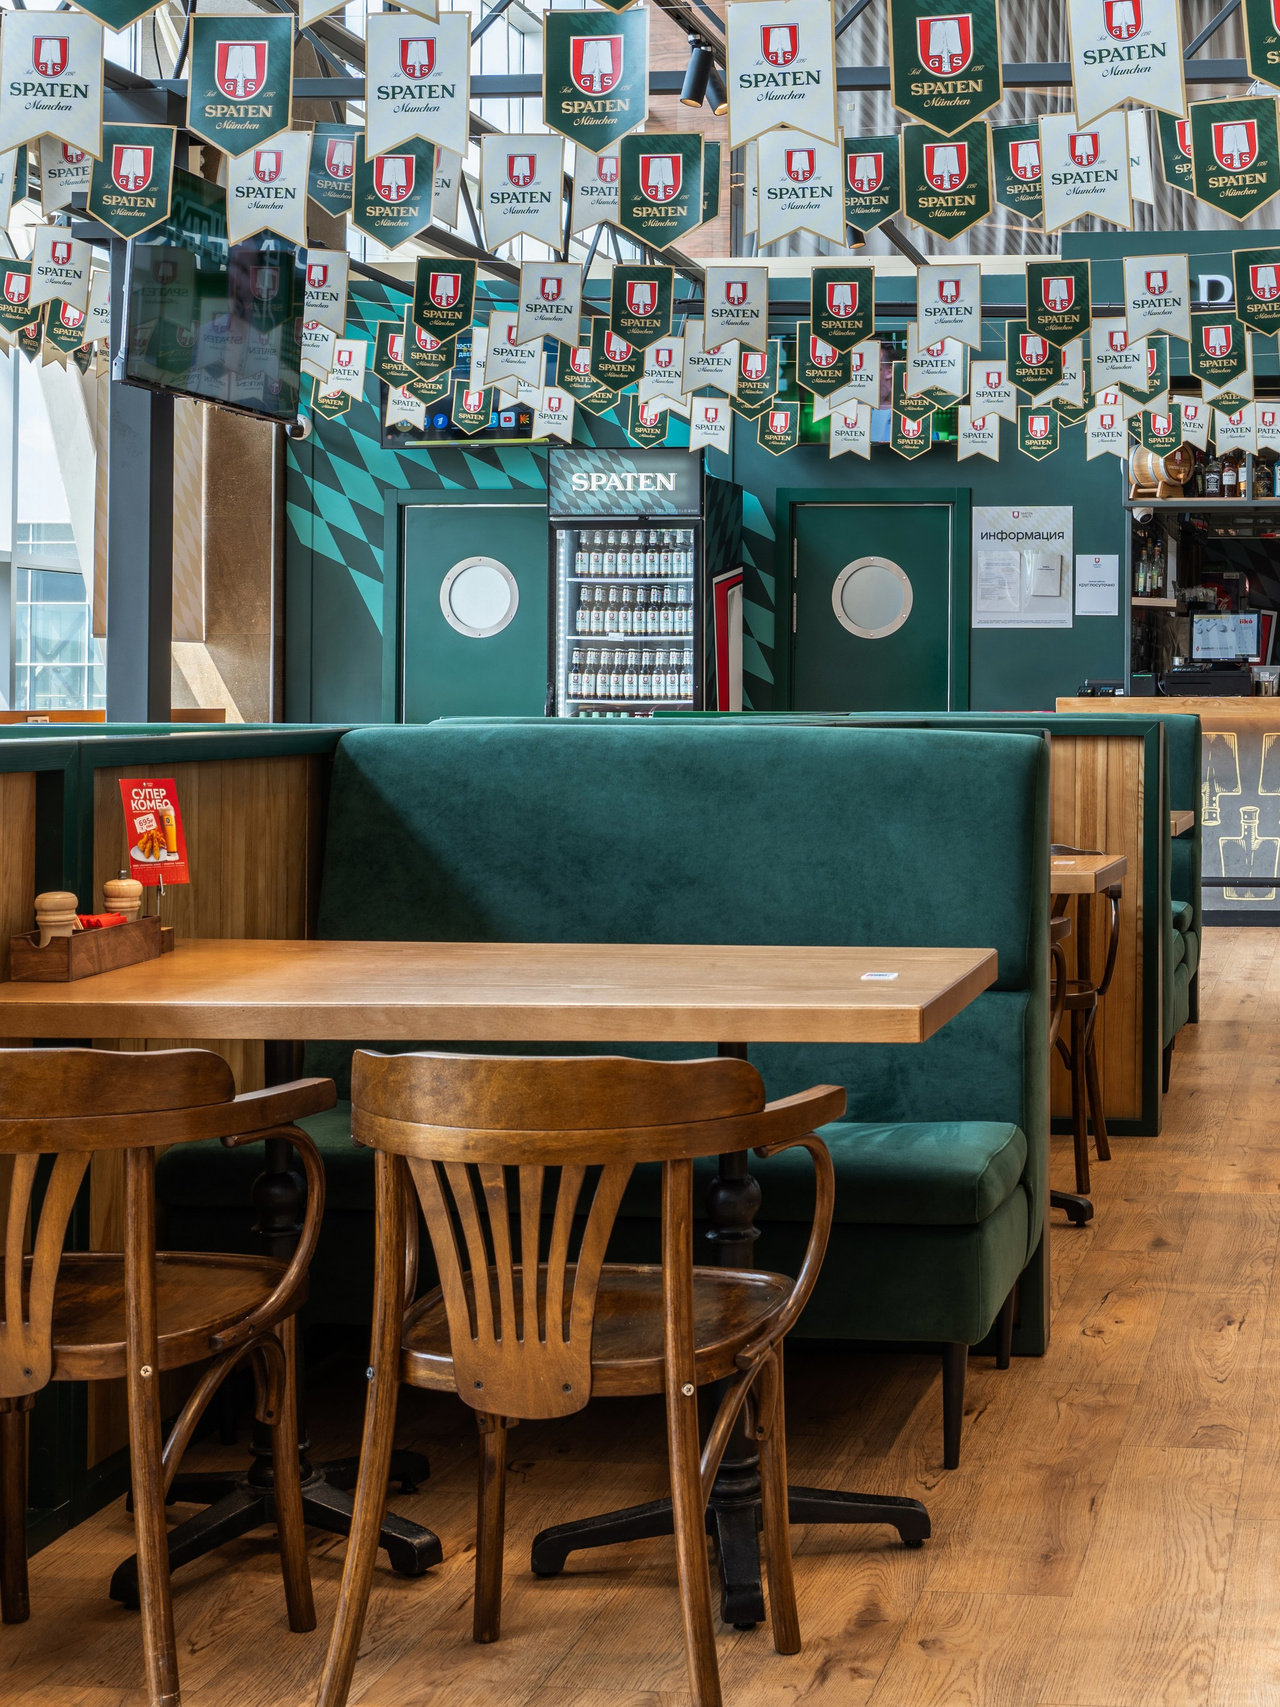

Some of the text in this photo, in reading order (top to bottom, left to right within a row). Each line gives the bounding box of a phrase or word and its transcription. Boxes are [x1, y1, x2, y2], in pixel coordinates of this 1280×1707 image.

[1083, 42, 1167, 65] SPATEN
[739, 70, 821, 89] SPATEN
[9, 82, 89, 99] SPATEN
[376, 84, 456, 100] SPATEN
[910, 79, 984, 96] SPATEN
[561, 99, 630, 114] SPATEN
[923, 97, 971, 107] München
[205, 104, 273, 118] SPATEN
[215, 119, 260, 130] München
[573, 115, 618, 126] München
[1051, 169, 1118, 186] SPATEN
[1208, 171, 1267, 189] SPATEN
[235, 186, 297, 199] SPATEN
[490, 192, 551, 204] SPATEN
[767, 185, 834, 200] SPATEN
[102, 195, 156, 208] SPATEN
[918, 194, 976, 208] SPATEN
[366, 206, 419, 217] SPATEN
[632, 205, 687, 218] SPATEN
[37, 266, 82, 279] SPATEN
[525, 303, 573, 314] SPATEN
[1132, 298, 1182, 309] SPATEN
[0, 304, 31, 315] SPATEN
[422, 309, 463, 319] SPATEN
[711, 309, 760, 318] SPATEN
[925, 306, 973, 317] SPATEN
[620, 318, 661, 327] SPATEN
[821, 320, 863, 329] SPATEN
[1037, 314, 1080, 324] SPATEN
[53, 328, 84, 337] SPATEN
[410, 352, 446, 361] SPATEN
[493, 347, 536, 358] SPATEN
[689, 357, 732, 366] SPATEN
[913, 359, 956, 368] SPATEN
[1097, 353, 1141, 364] SPATEN
[1200, 358, 1237, 368] SPATEN
[598, 363, 635, 372] SPATEN
[1016, 367, 1054, 376] SPATEN
[564, 375, 597, 384] SPATEN
[645, 370, 682, 378] SPATEN
[413, 382, 443, 391] SPATEN
[737, 382, 769, 390] SPATEN
[391, 399, 422, 407] SPATEN
[458, 413, 485, 421] SPATEN
[538, 412, 569, 421] SPATEN
[764, 434, 791, 442] SPATEN
[834, 430, 865, 438] SPATEN
[571, 473, 677, 491] SPATEN
[980, 530, 1065, 542] информация
[132, 788, 166, 799] СУПЕР
[131, 799, 171, 810] КОМБО
